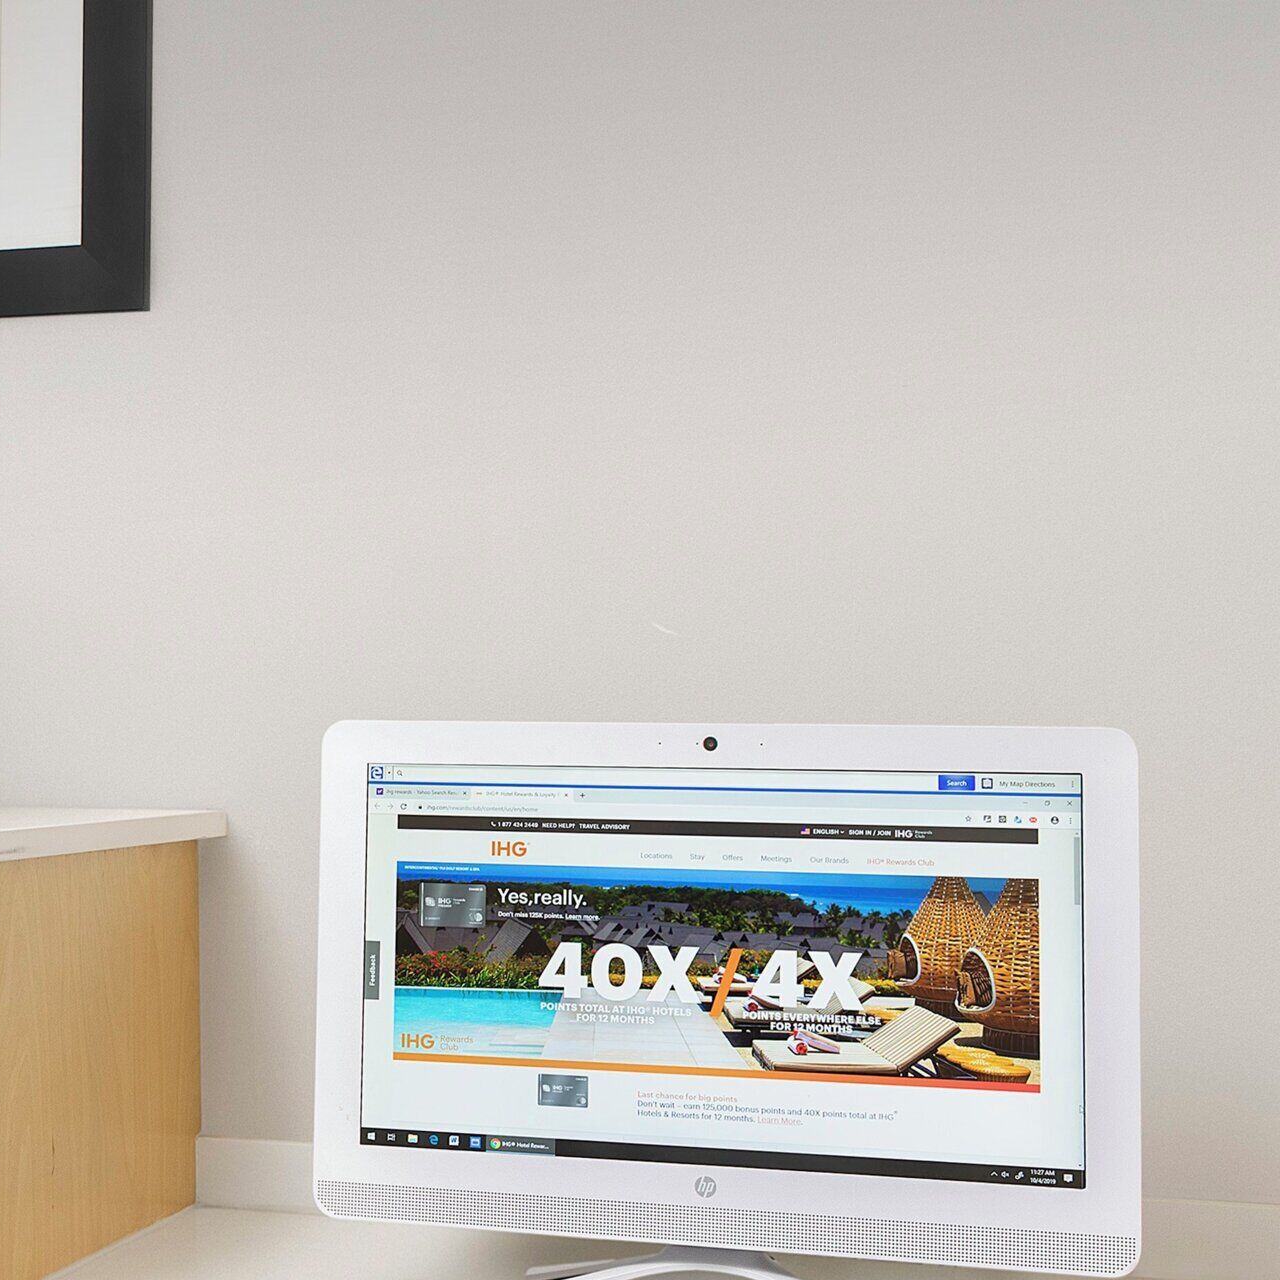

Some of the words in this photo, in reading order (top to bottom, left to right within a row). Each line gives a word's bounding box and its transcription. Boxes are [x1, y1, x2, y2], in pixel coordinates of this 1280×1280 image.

[946, 779, 967, 788] Search
[1010, 781, 1023, 789] Map
[877, 829, 891, 837] JOIN
[894, 829, 912, 839] IHG
[491, 841, 527, 857] IHG
[640, 852, 673, 860] Locations
[690, 853, 705, 862] Stay
[722, 854, 743, 862] Offers
[760, 855, 792, 864] Meetings
[809, 856, 823, 864] Our
[825, 856, 849, 865] Brands
[886, 858, 916, 867] Rewards
[917, 858, 935, 867] Club
[497, 888, 587, 909] Yes,really.
[529, 911, 543, 919] 125K
[544, 912, 565, 920] points.
[538, 941, 701, 1003] 40X
[751, 950, 864, 1011] 4X
[540, 1002, 578, 1013] POINTS
[579, 1003, 609, 1013] TOTAL
[610, 1004, 624, 1014] AT
[652, 1006, 692, 1017] HOTELS
[576, 1012, 596, 1022] FOR
[598, 1014, 609, 1023] 12
[611, 1014, 655, 1024] MONTHS
[742, 1011, 781, 1021] POINTS
[782, 1012, 854, 1024] EVERYWHERE
[856, 1015, 881, 1025] ELSE
[770, 1021, 792, 1031] FOR
[793, 1022, 804, 1032] 12
[806, 1023, 852, 1034] MONTHS
[401, 1033, 435, 1049] IHG
[440, 1035, 474, 1044] Rewards
[440, 1042, 459, 1051] Club
[638, 1090, 653, 1099] Last
[655, 1092, 683, 1100] chance
[698, 1093, 711, 1102] big
[713, 1095, 738, 1103] points
[638, 1100, 658, 1108] Don't
[659, 1101, 675, 1109] wait
[702, 1104, 733, 1112] 125,000
[735, 1105, 759, 1113] bonus
[761, 1106, 786, 1116] points
[787, 1108, 803, 1116] and
[822, 1110, 847, 1119] points
[849, 1111, 867, 1119] total
[868, 1112, 877, 1120] at
[637, 1109, 662, 1118] Hotels
[671, 1111, 700, 1120] Resorts
[714, 1113, 722, 1121] 12
[724, 1113, 755, 1122] months.
[757, 1116, 777, 1125] Learn
[779, 1117, 803, 1126] More.
